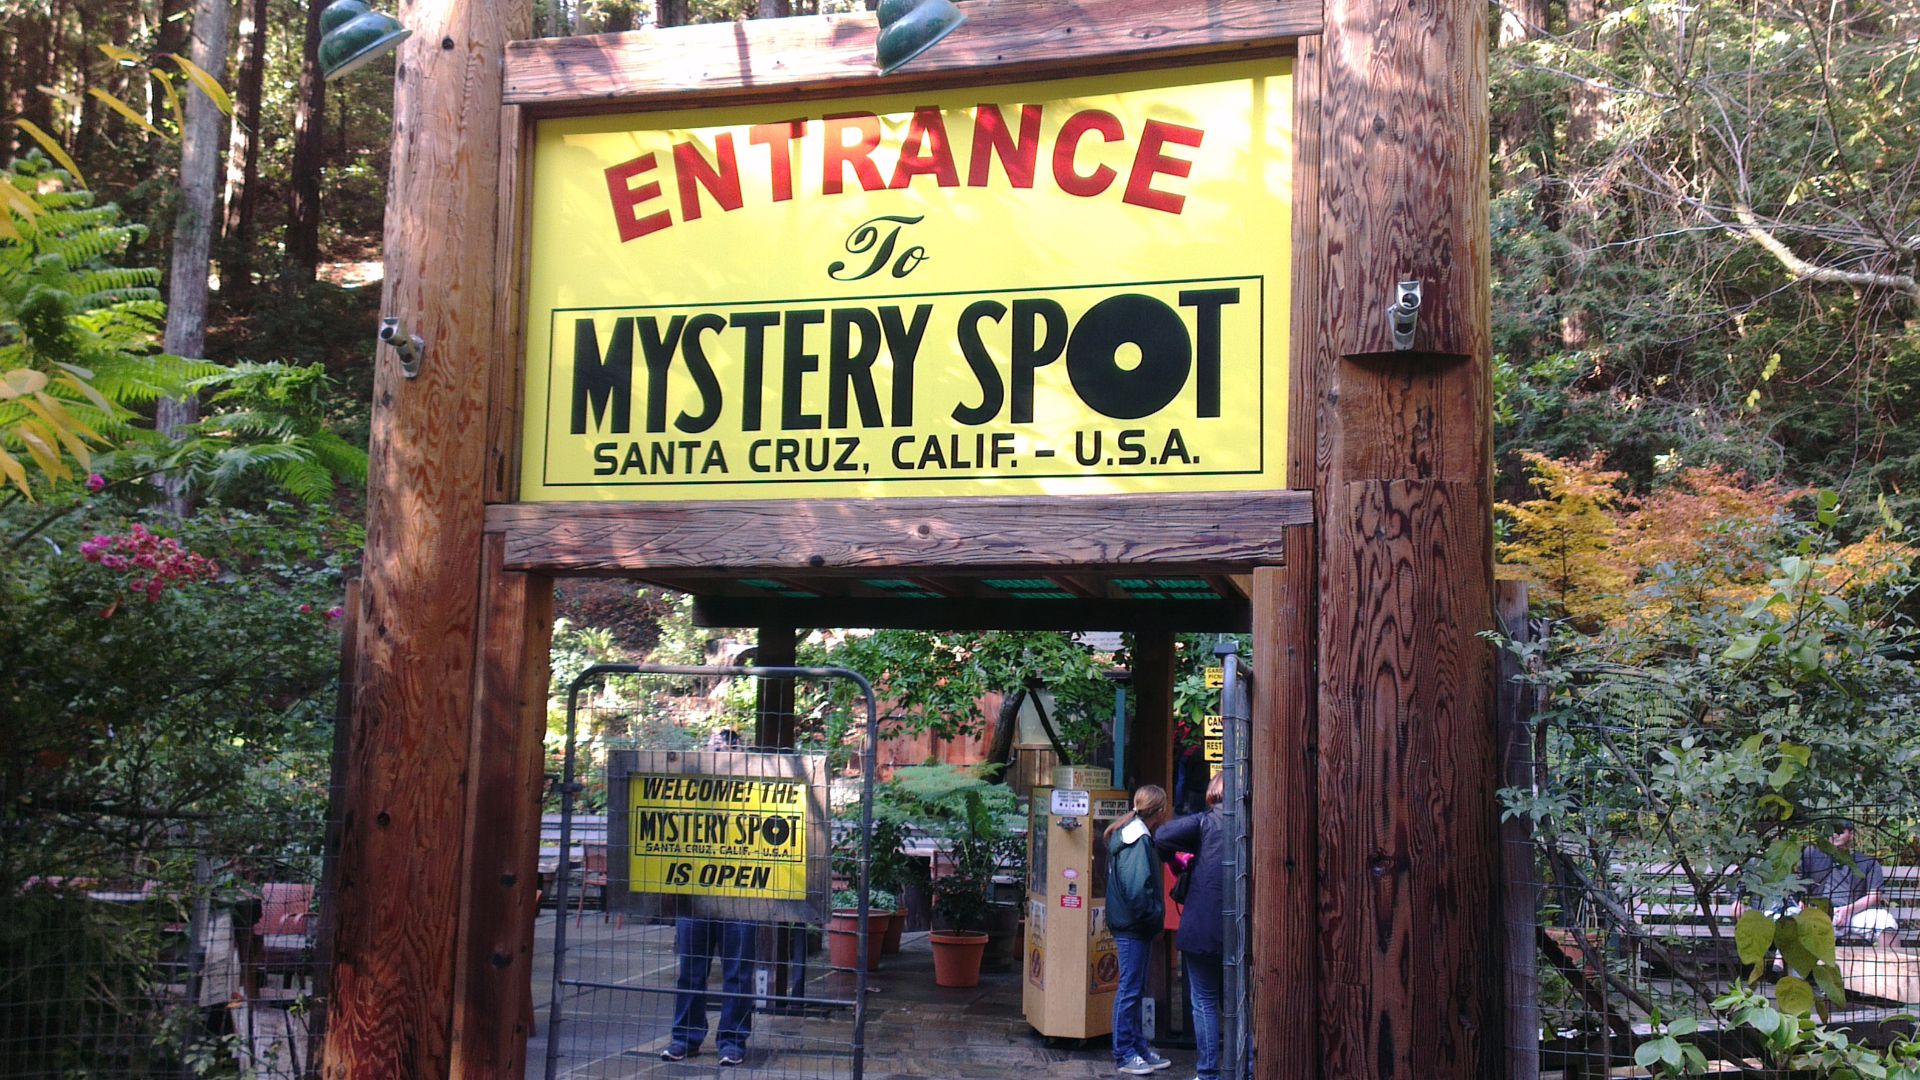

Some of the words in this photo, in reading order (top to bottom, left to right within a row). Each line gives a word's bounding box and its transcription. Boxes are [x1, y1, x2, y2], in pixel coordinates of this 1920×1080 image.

[604, 103, 1204, 243] ENTRANCE
[827, 215, 930, 281] To
[570, 303, 934, 435] MYSTERY
[950, 287, 1240, 426] SPOT
[593, 440, 729, 475] SANTA
[748, 437, 869, 475] CRUZ,
[891, 433, 1018, 470] CALIF.
[1075, 428, 1200, 466] U.S.A.
[642, 777, 752, 803] WELCOME!
[761, 782, 799, 804] THE
[639, 811, 731, 844] MYSTERY
[735, 814, 801, 847] SPOT
[645, 844, 681, 854] SANTA
[719, 845, 751, 856] CALIF.
[665, 863, 692, 886] IS
[698, 864, 771, 889] OPEN
